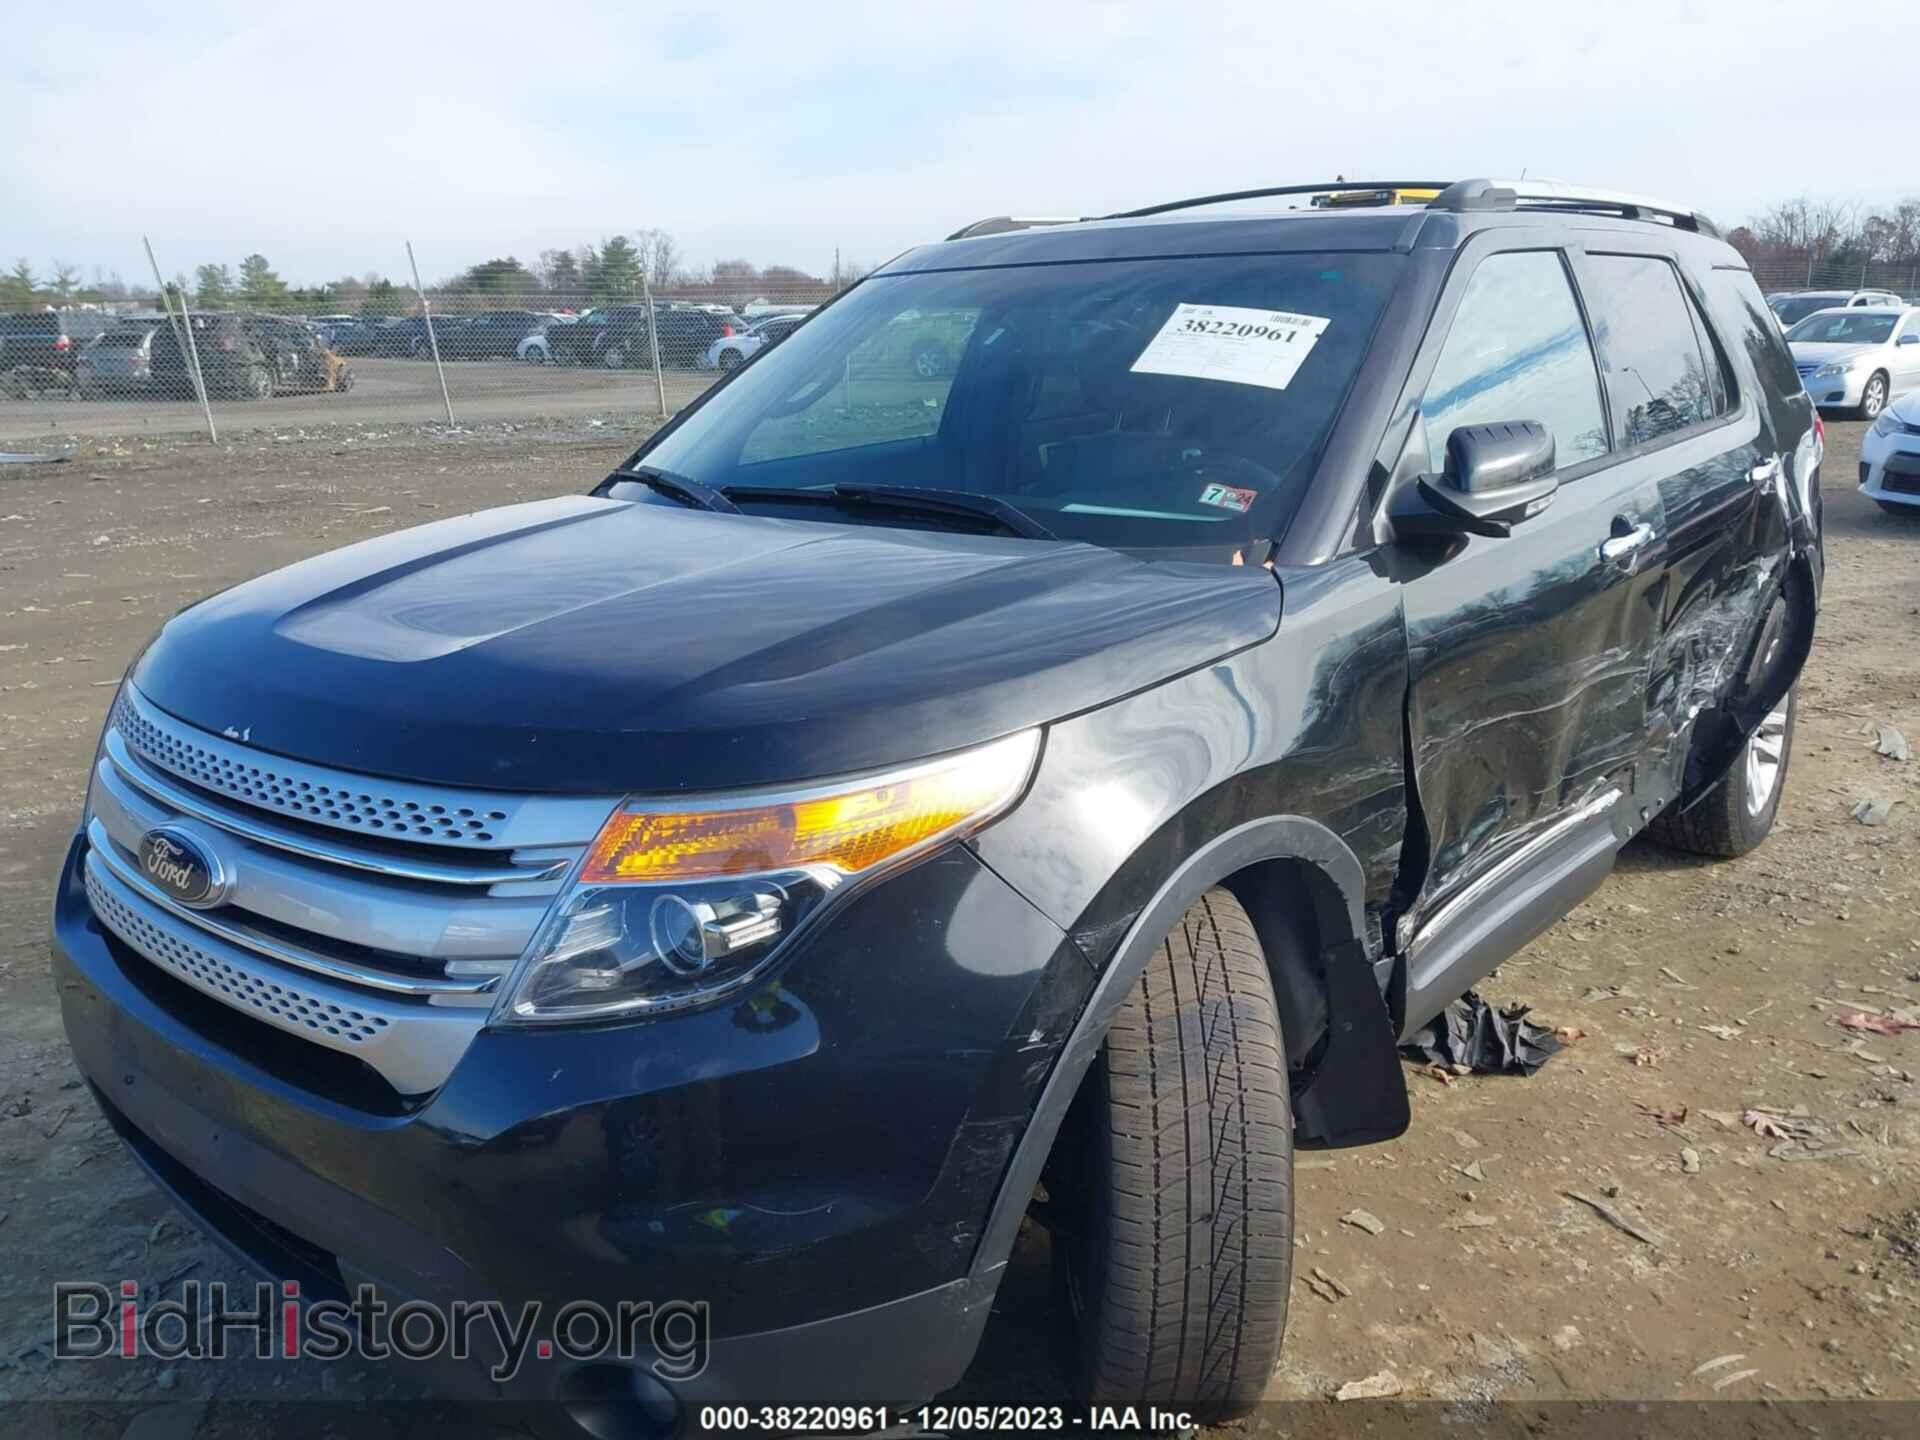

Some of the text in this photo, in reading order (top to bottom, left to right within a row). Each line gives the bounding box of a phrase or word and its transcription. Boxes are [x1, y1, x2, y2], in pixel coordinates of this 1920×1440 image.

[1177, 319, 1298, 343] 38220961
[1208, 488, 1223, 501] 7
[148, 838, 194, 889] Ford
